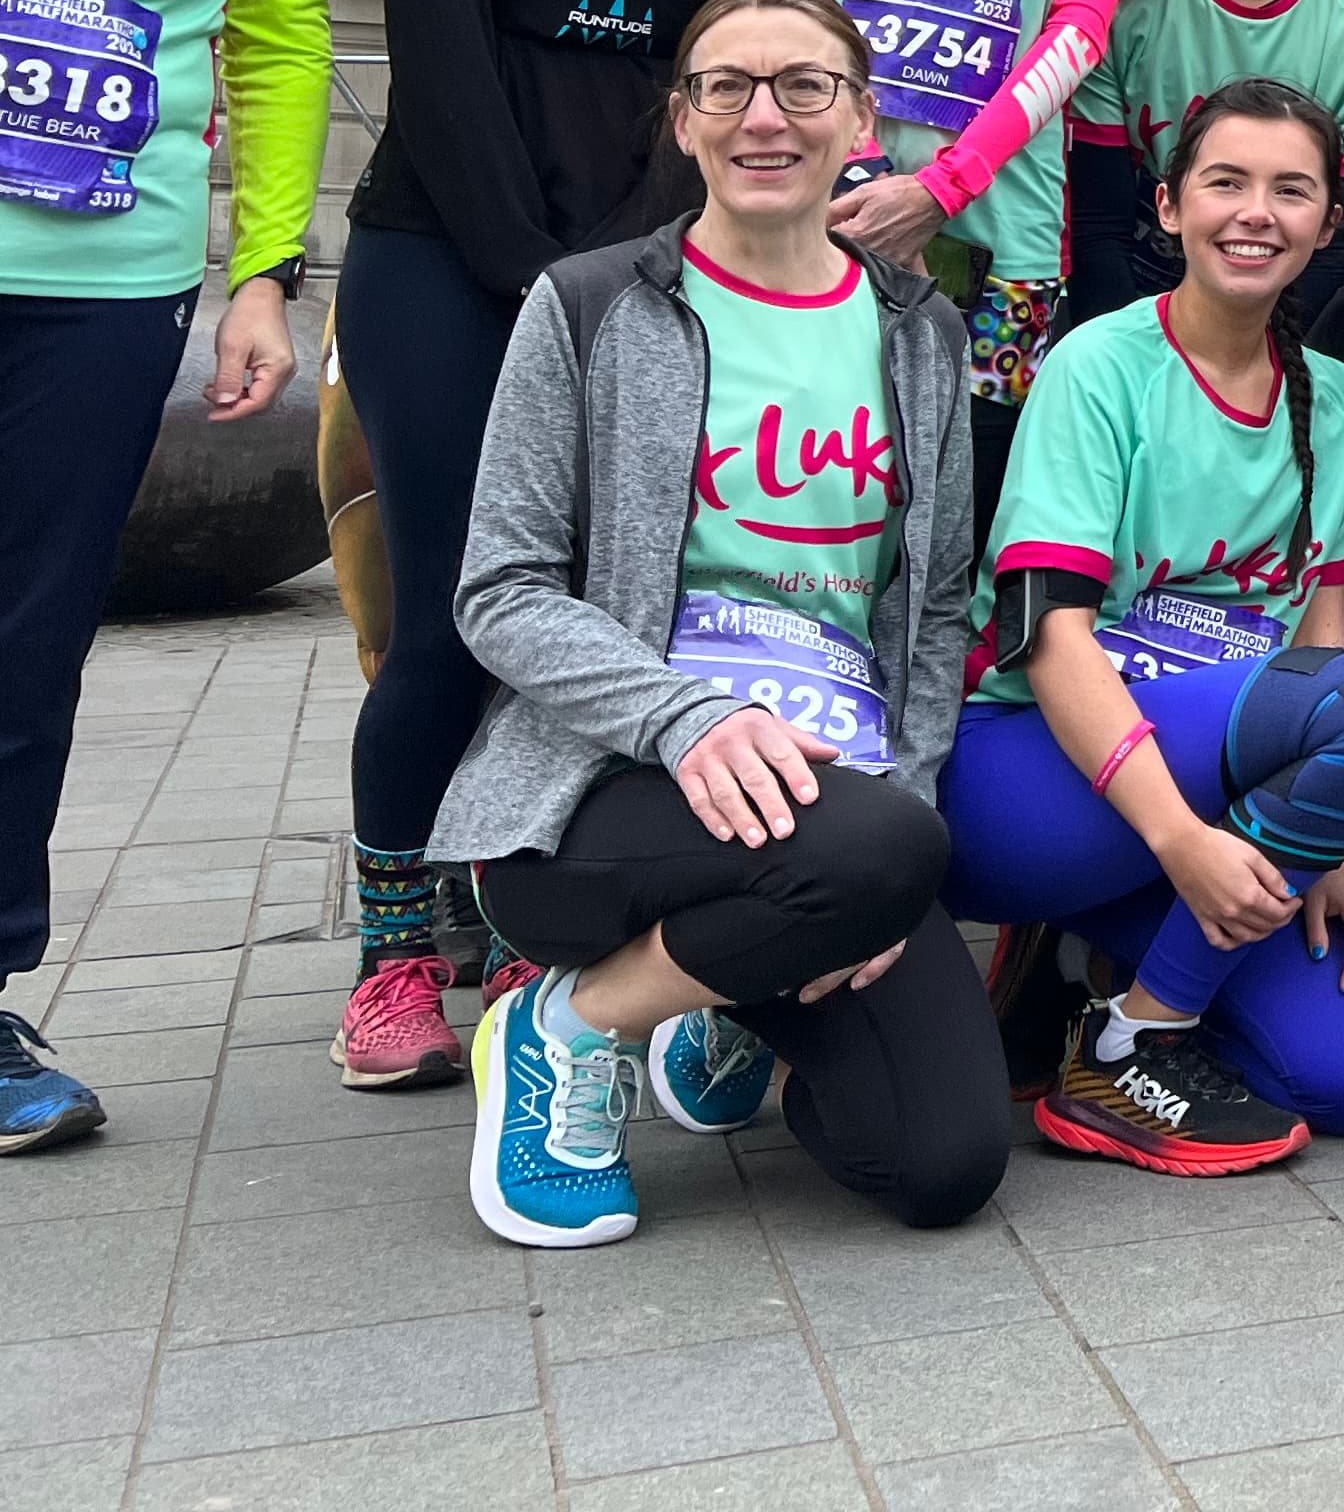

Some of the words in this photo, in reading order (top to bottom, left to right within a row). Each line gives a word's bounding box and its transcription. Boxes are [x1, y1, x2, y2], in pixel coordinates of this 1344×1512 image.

[17, 1, 62, 19] HALF
[64, 11, 142, 38] MARATHO
[568, 10, 653, 34] RUNITUDE
[871, 14, 993, 76] 3754
[0, 53, 132, 122] 318
[902, 65, 950, 87] DAWN
[1011, 24, 1101, 140] NIKE
[45, 118, 101, 141] BEAR
[89, 191, 133, 208] 3318
[748, 608, 818, 635] SHEFFIELD
[1160, 597, 1224, 623] SHEFFIELD
[745, 621, 785, 639] HALF
[1156, 611, 1190, 629] HALF
[1192, 621, 1270, 651] MARATHON
[825, 654, 871, 684] 2023
[1113, 1065, 1190, 1128] HOKA
